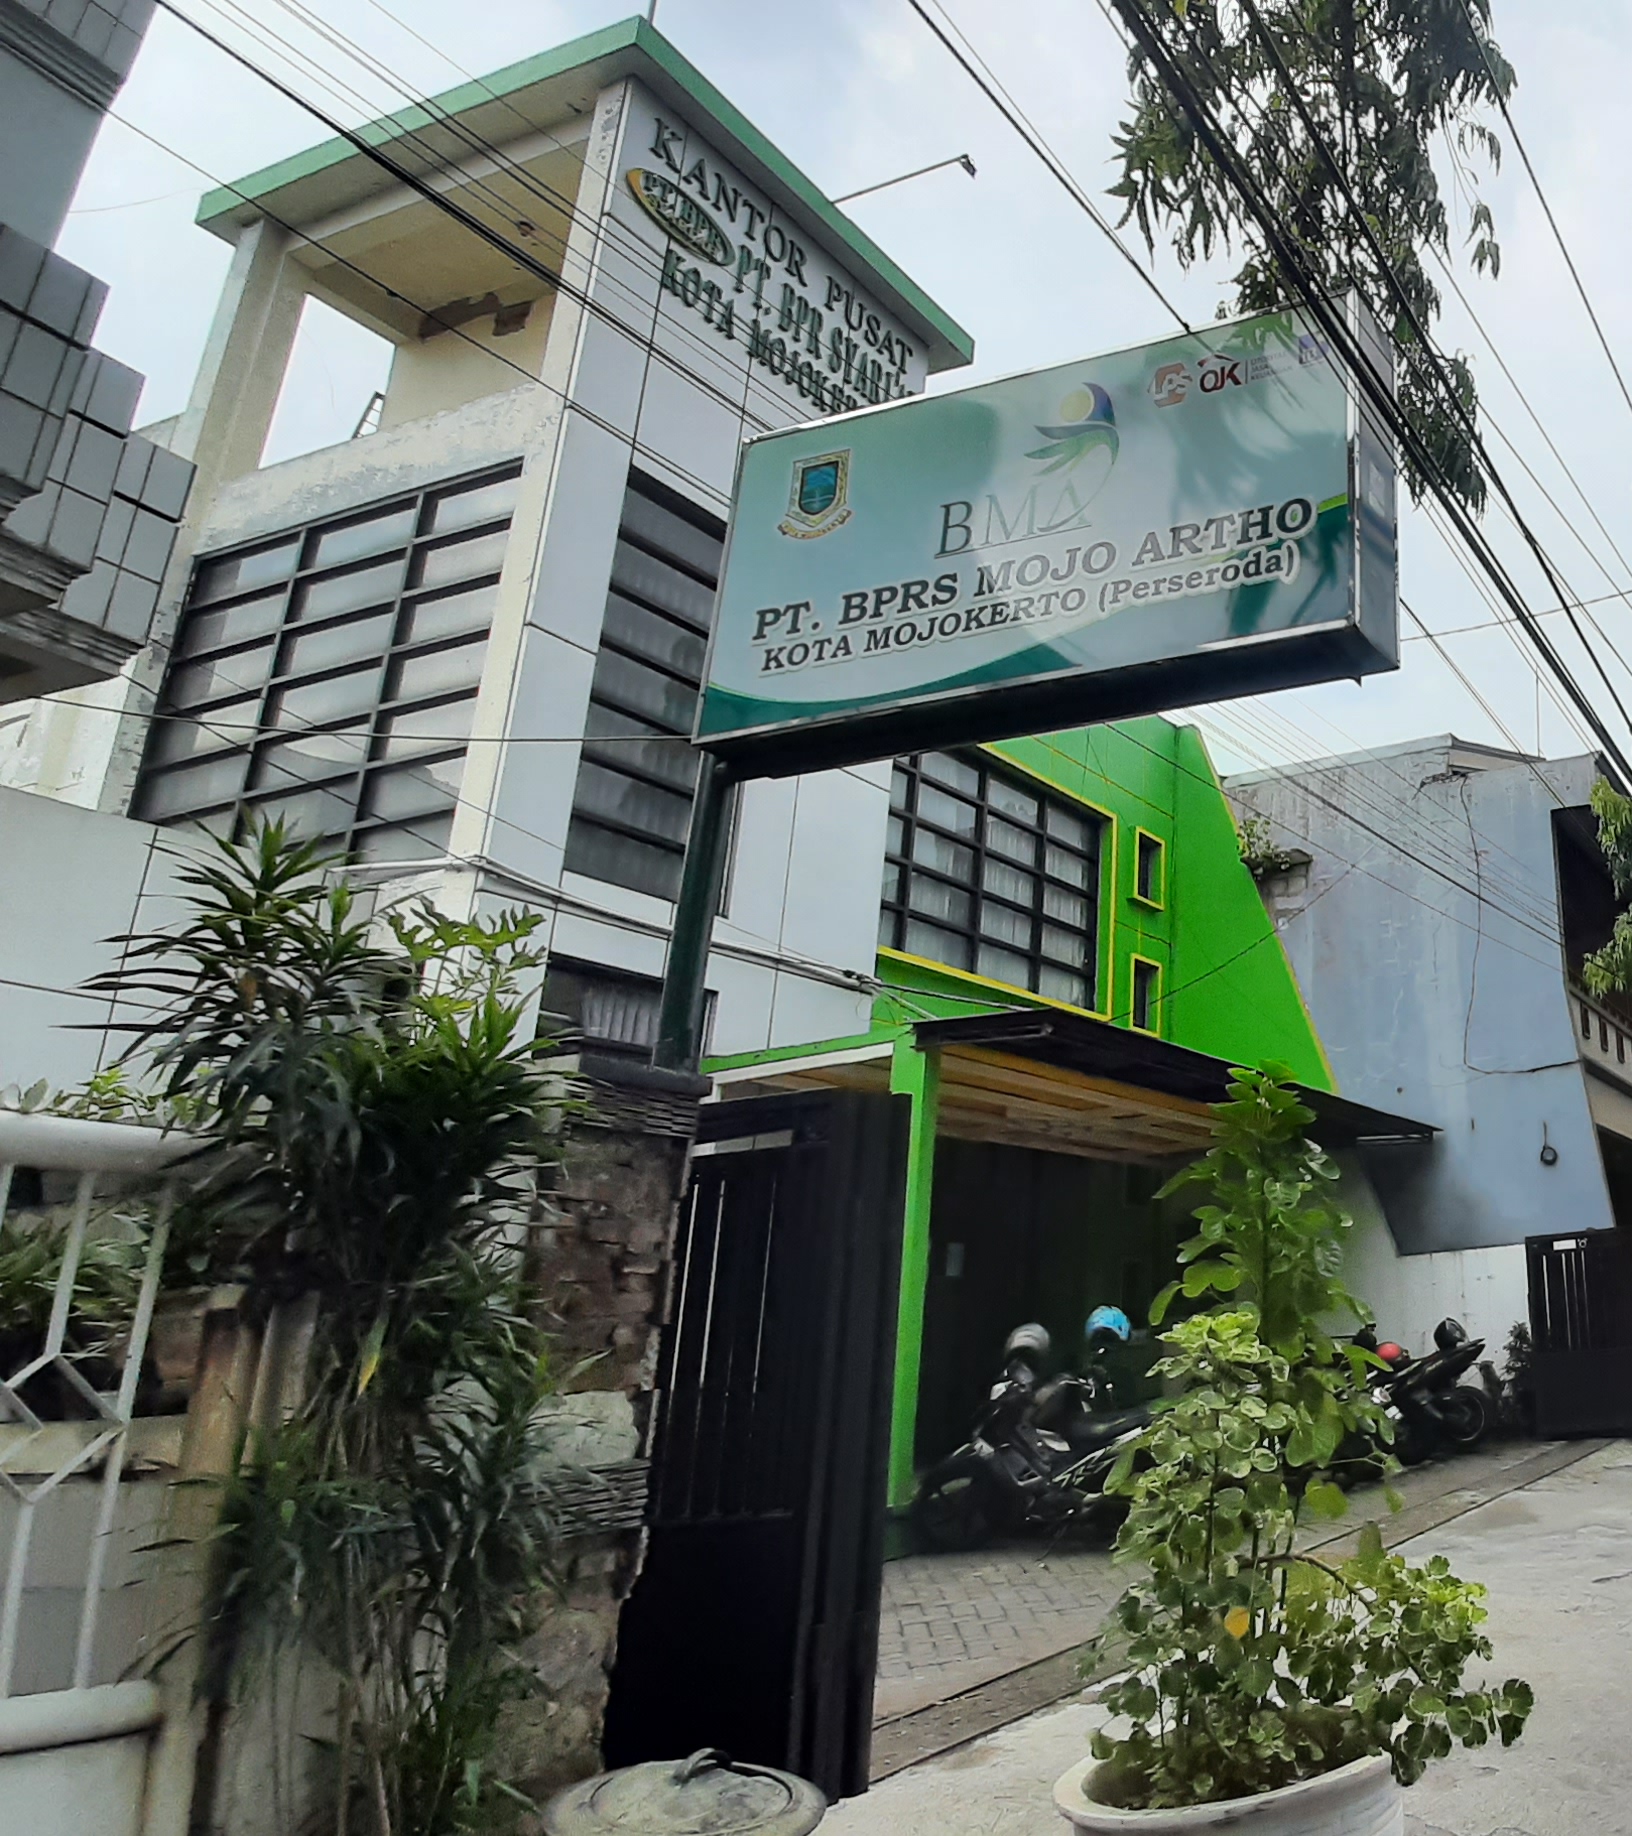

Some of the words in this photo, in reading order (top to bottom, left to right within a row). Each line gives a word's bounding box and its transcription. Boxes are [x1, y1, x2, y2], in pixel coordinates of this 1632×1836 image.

[649, 117, 808, 288] KANTOR
[824, 275, 913, 375] PUSAT
[663, 248, 736, 340] KOTA
[733, 245, 771, 316] PT.
[778, 283, 822, 360] BPR
[1199, 361, 1242, 393] OJK
[752, 601, 820, 640] PT.
[838, 573, 958, 625] BPRS
[973, 541, 1117, 597] MOJO
[1131, 498, 1312, 566] ARTHO
[936, 478, 1091, 556] BMA
[761, 635, 852, 671] KOTA
[863, 588, 1086, 652] MOJOKERTO
[1098, 545, 1293, 612] (Perseroda)
